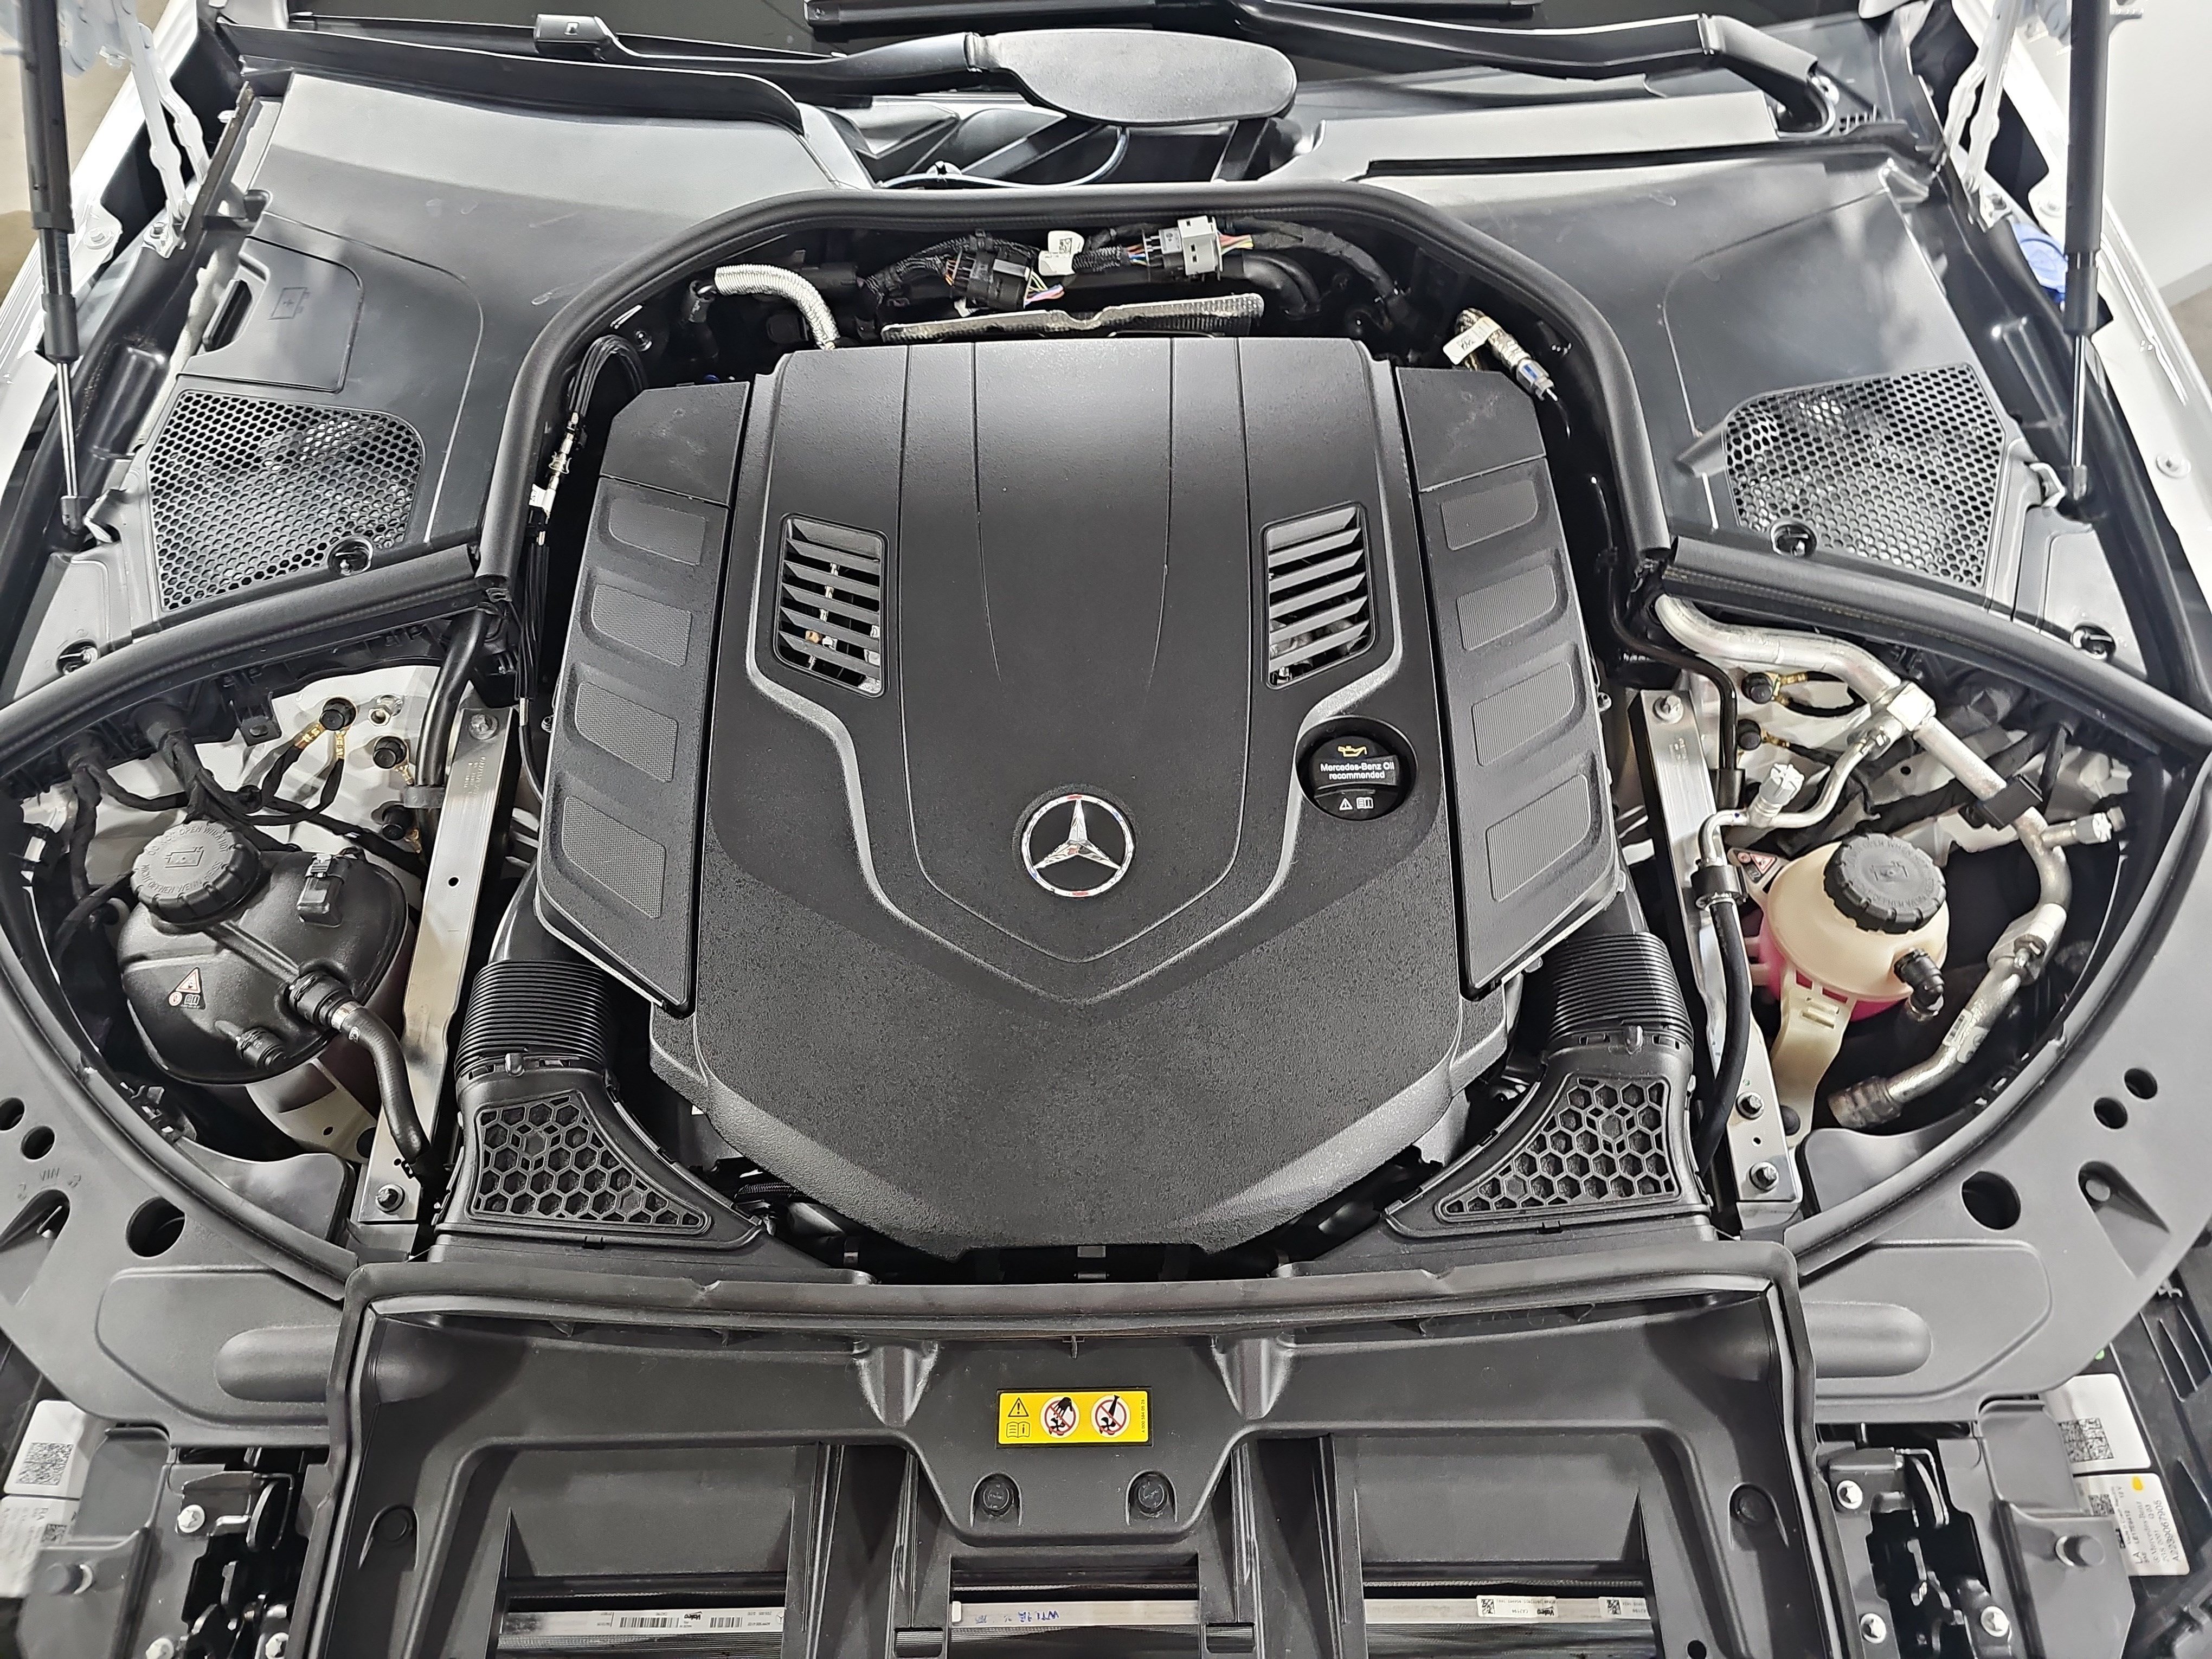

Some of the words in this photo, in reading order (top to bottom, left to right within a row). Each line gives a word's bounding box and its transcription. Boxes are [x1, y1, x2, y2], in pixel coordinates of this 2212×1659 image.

[1320, 762, 1382, 771] Mercedes-Benz
[1383, 761, 1395, 770] Oil
[1329, 770, 1385, 780] recommended
[179, 826, 202, 835] OPEN
[203, 826, 224, 840] WHEN
[1537, 1608, 1555, 1616] Valeo
